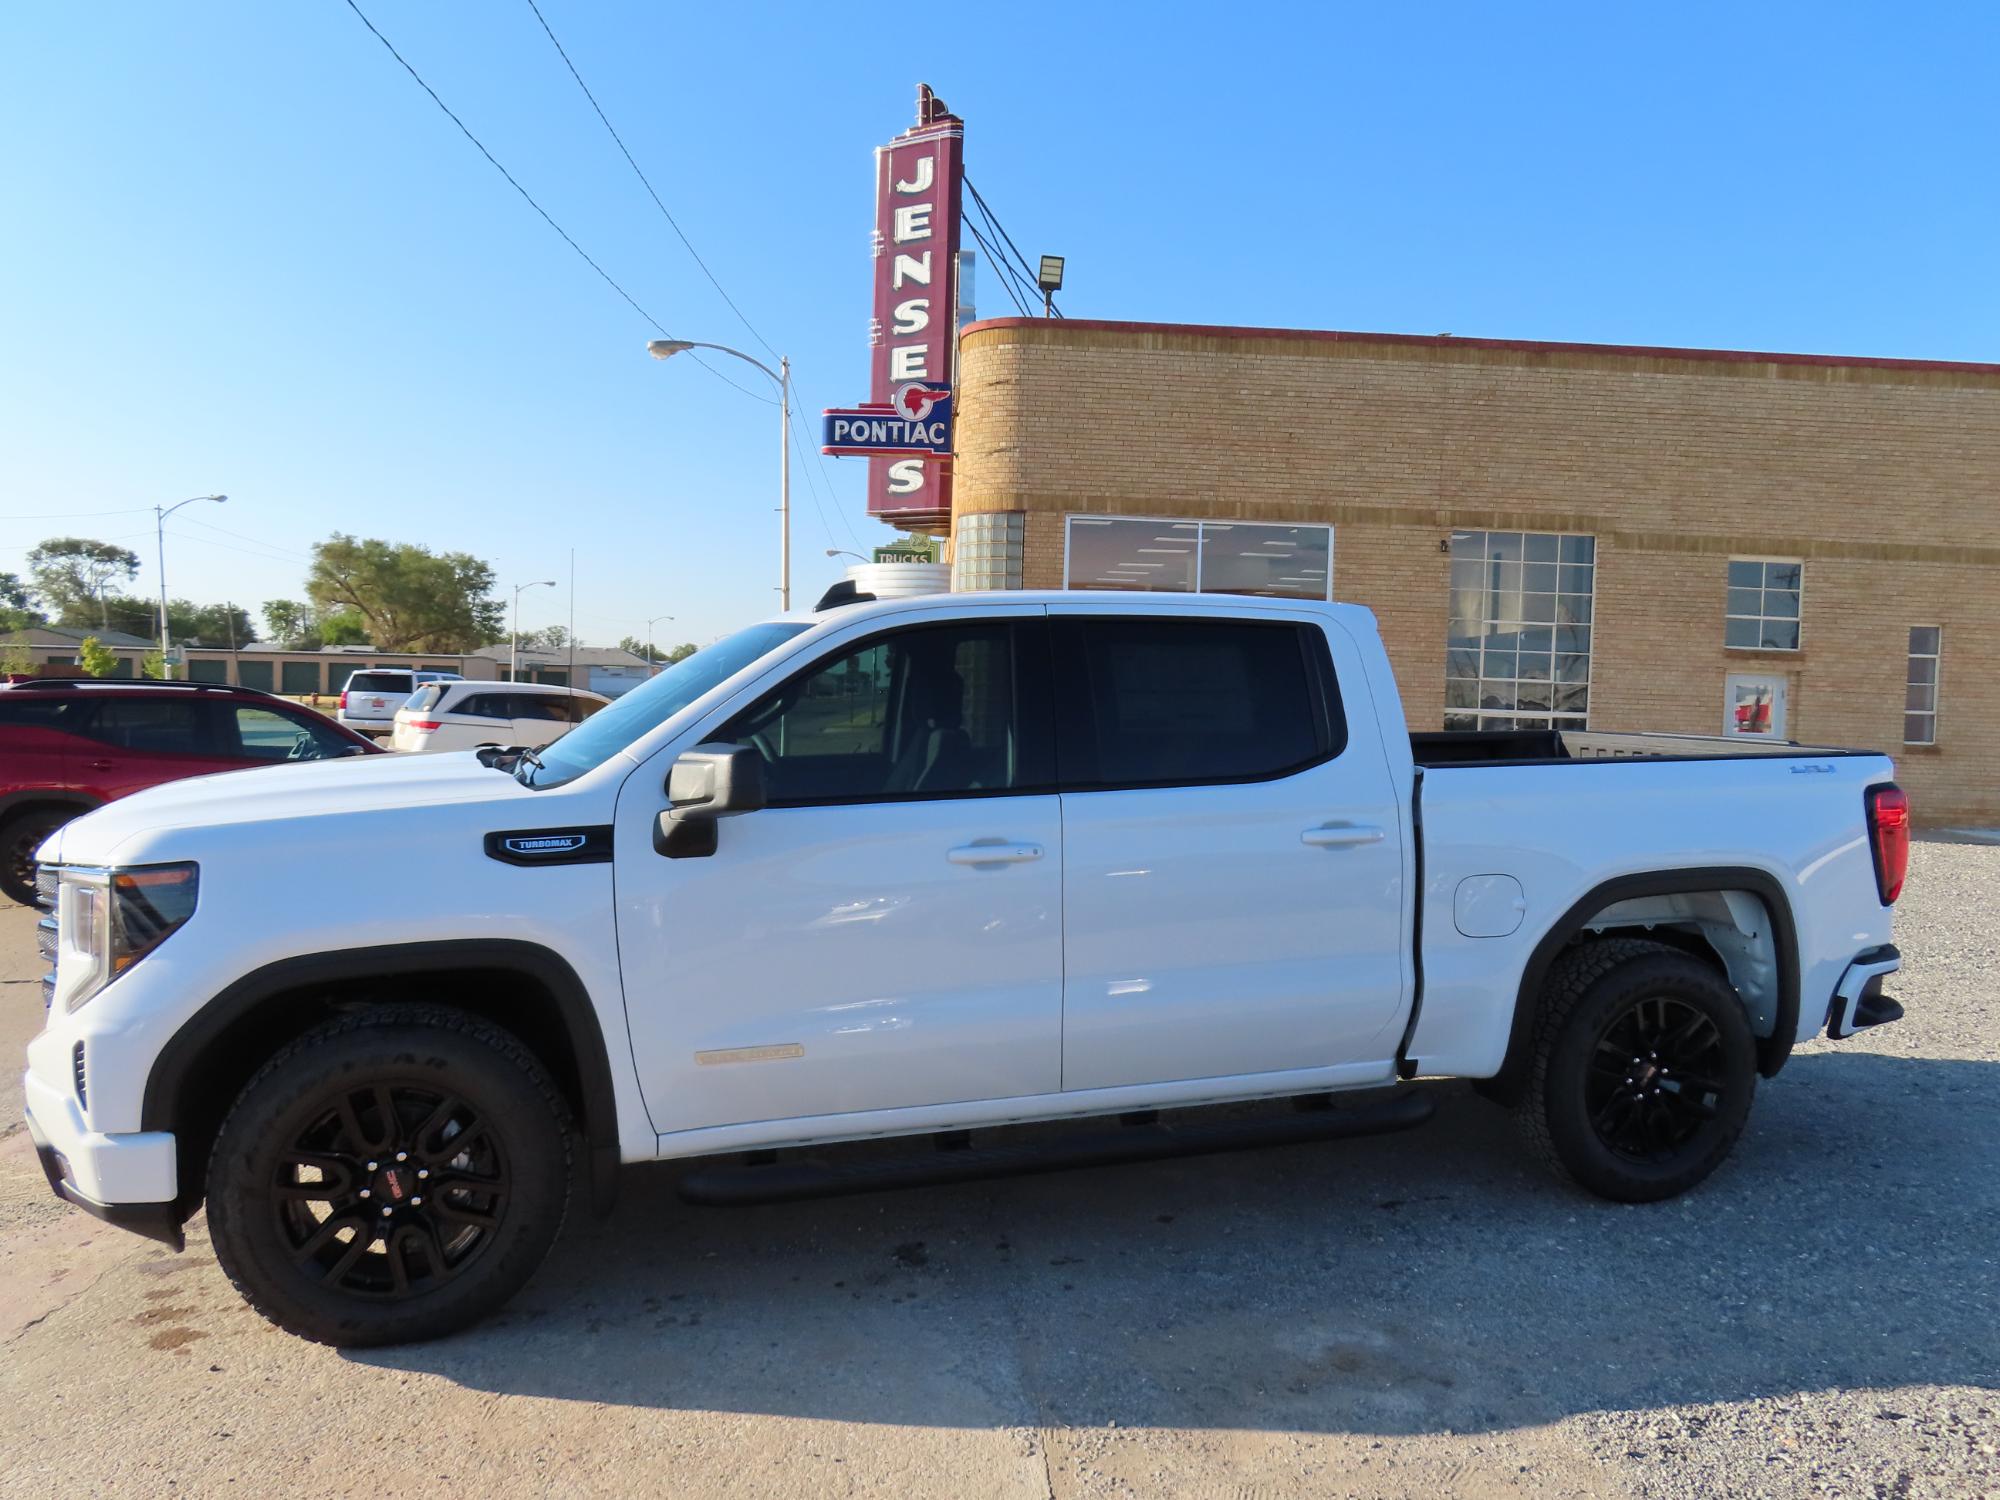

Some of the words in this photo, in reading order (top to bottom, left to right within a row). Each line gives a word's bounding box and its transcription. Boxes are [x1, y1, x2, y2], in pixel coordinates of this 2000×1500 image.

[834, 419, 945, 445] PONTIAC
[879, 553, 928, 563] TRUCKS
[519, 838, 573, 849] TURBOMAX
